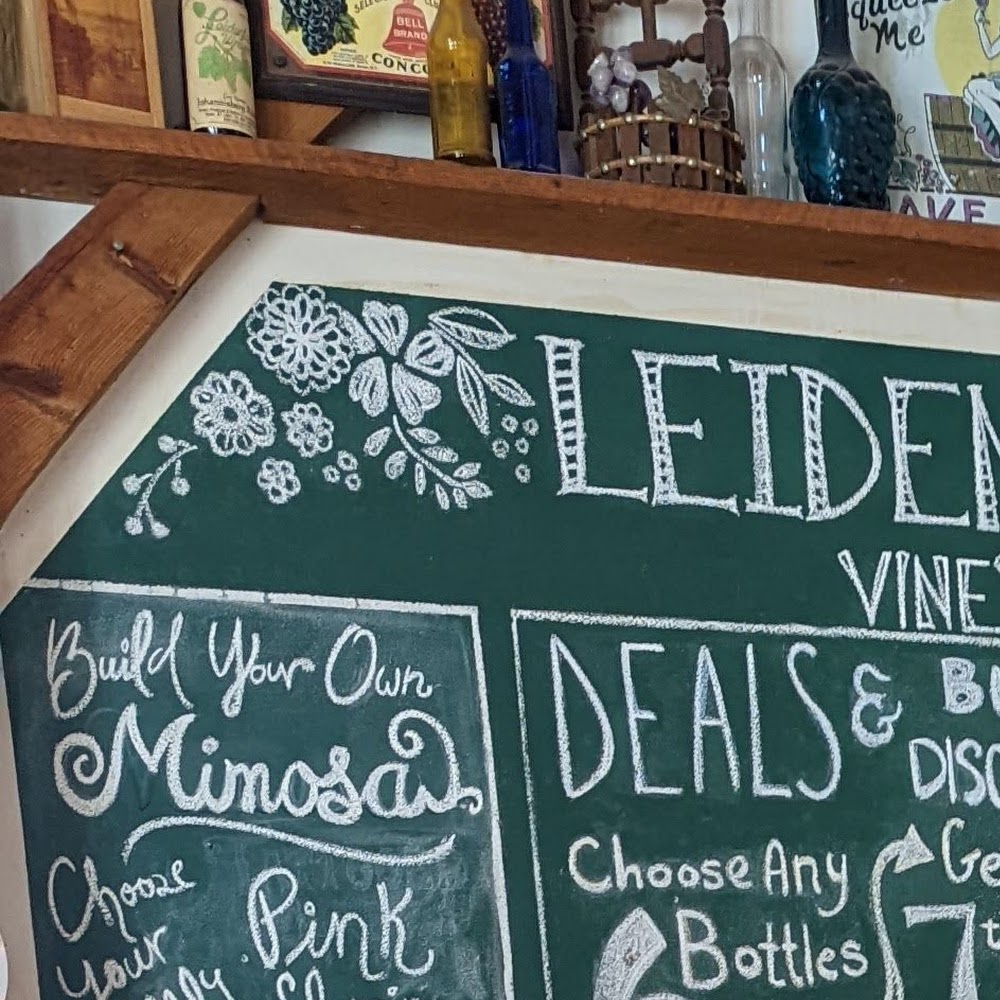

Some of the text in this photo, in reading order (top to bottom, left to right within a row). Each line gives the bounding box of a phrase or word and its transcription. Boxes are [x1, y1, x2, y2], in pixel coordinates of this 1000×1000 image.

[393, 28, 428, 41] BRAND
[396, 16, 424, 29] BELL
[870, 18, 925, 53] Me
[890, 193, 986, 227] AKE
[46, 609, 436, 720] Build Your Own
[549, 633, 903, 801] DEALS &
[568, 834, 850, 917] Choose Any
[247, 866, 435, 981] Pink
[675, 906, 869, 991] Bottles
